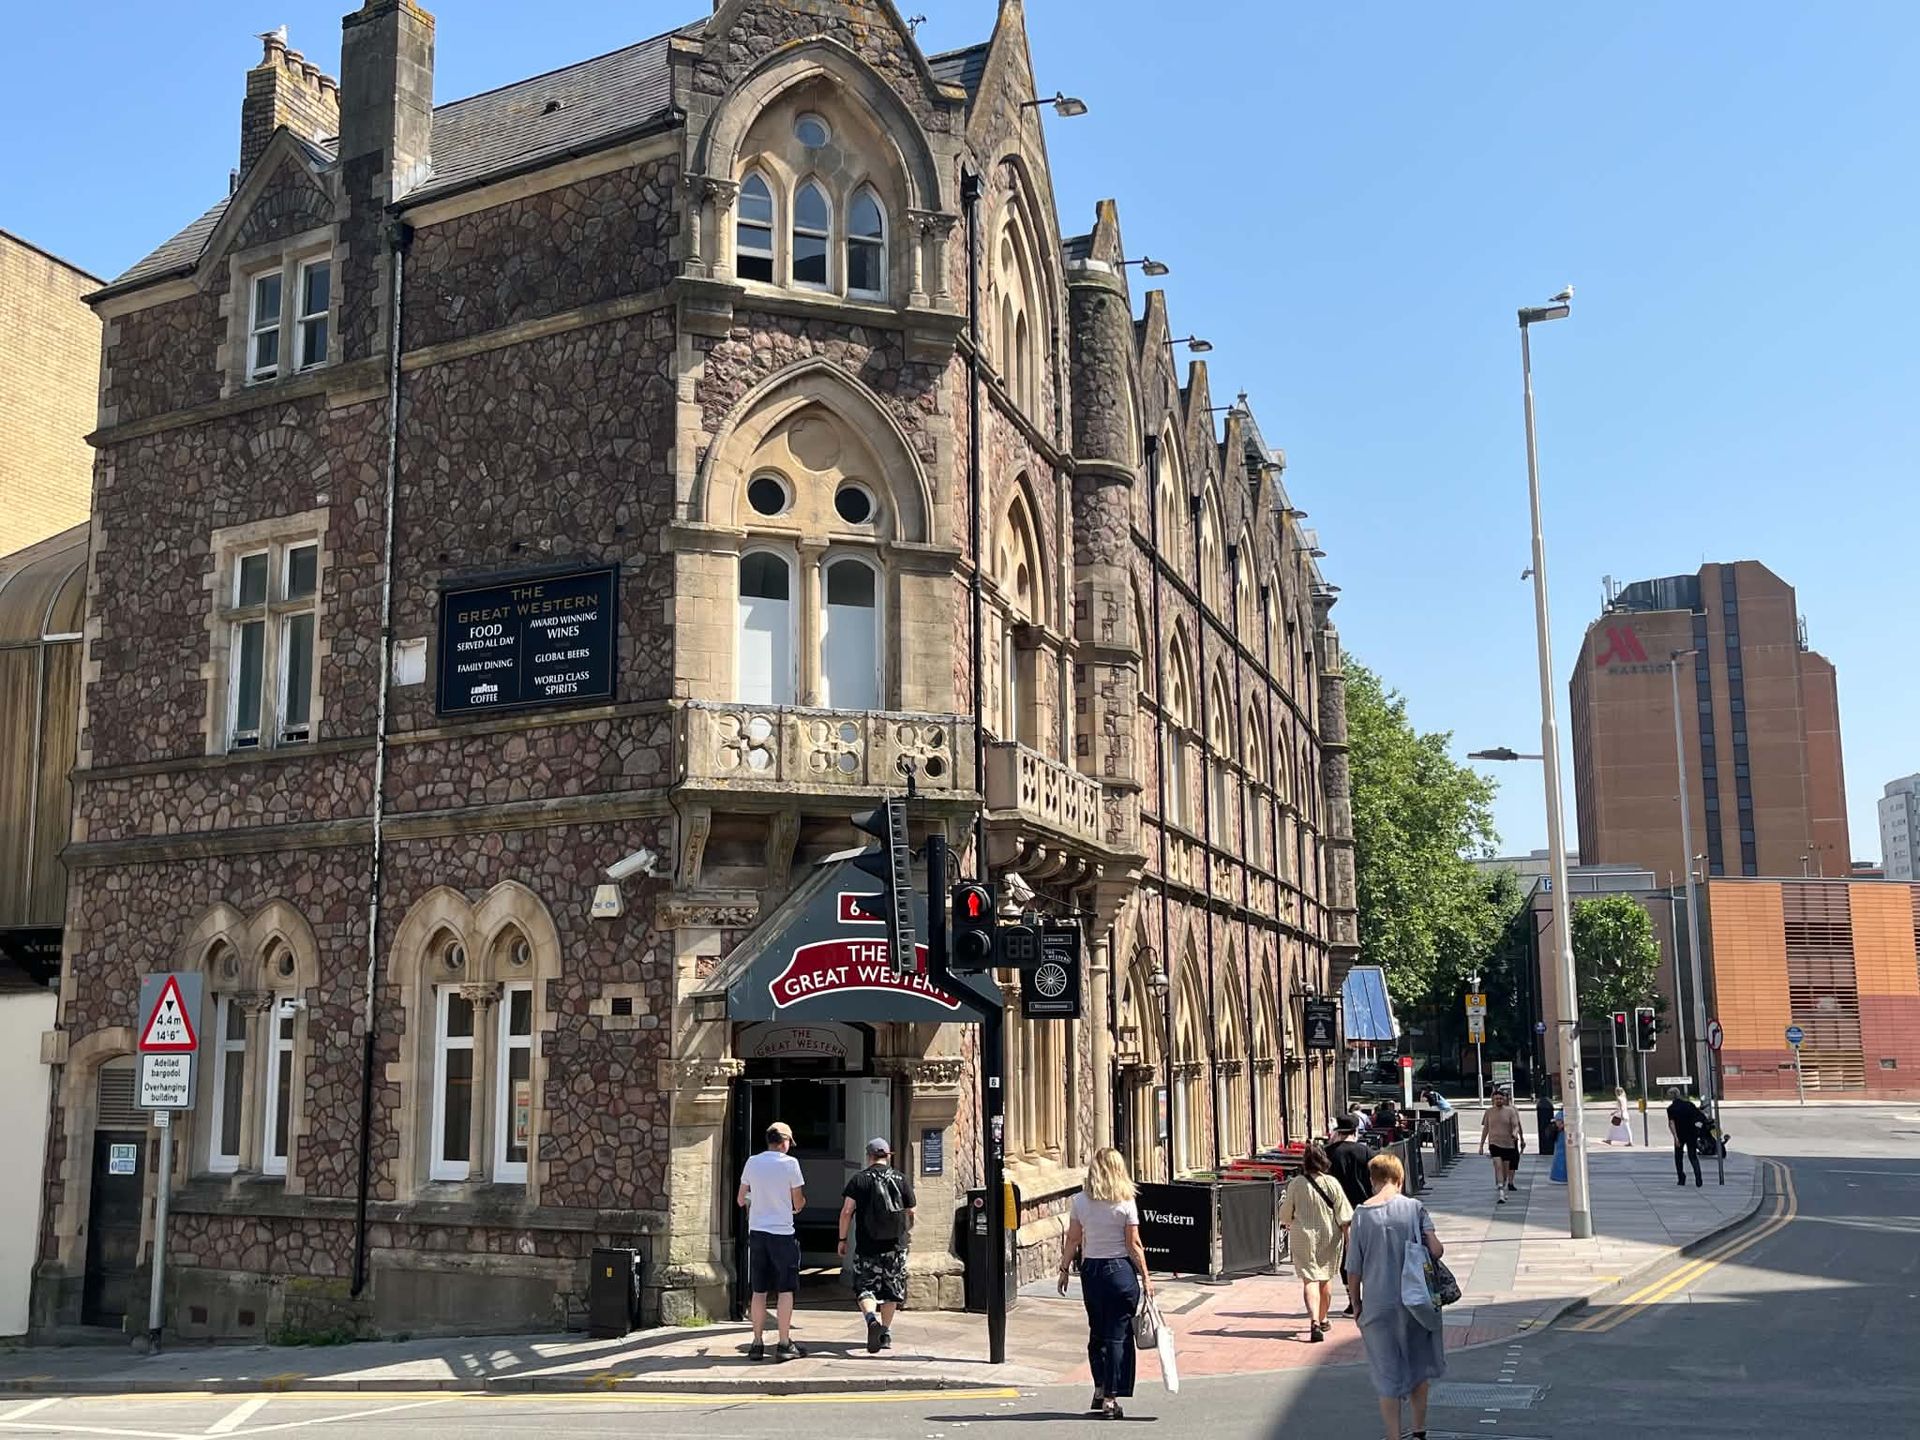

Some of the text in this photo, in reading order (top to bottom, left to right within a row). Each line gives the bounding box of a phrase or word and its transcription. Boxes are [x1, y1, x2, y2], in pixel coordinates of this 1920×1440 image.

[511, 586, 544, 601] THE
[458, 594, 599, 624] GREAT WESTERN
[530, 611, 597, 628] AWARD WINNING
[470, 623, 502, 639] FOOD
[547, 625, 580, 639] WINES
[457, 636, 515, 652] SERVED ALL DAY
[535, 648, 590, 663] GLOBAL BEERS
[457, 658, 513, 673] FAMILY DINING
[534, 671, 590, 685] WORLD CLASS
[545, 682, 578, 696] SPIRITS
[470, 693, 498, 704] COFFEE
[847, 945, 887, 962] THE
[784, 966, 849, 996] GREAT
[792, 1029, 811, 1039] THE
[796, 1040, 845, 1056] WESTERN
[144, 1082, 186, 1094] Overhanging
[151, 1094, 178, 1103] building
[1143, 1209, 1195, 1226] Western
